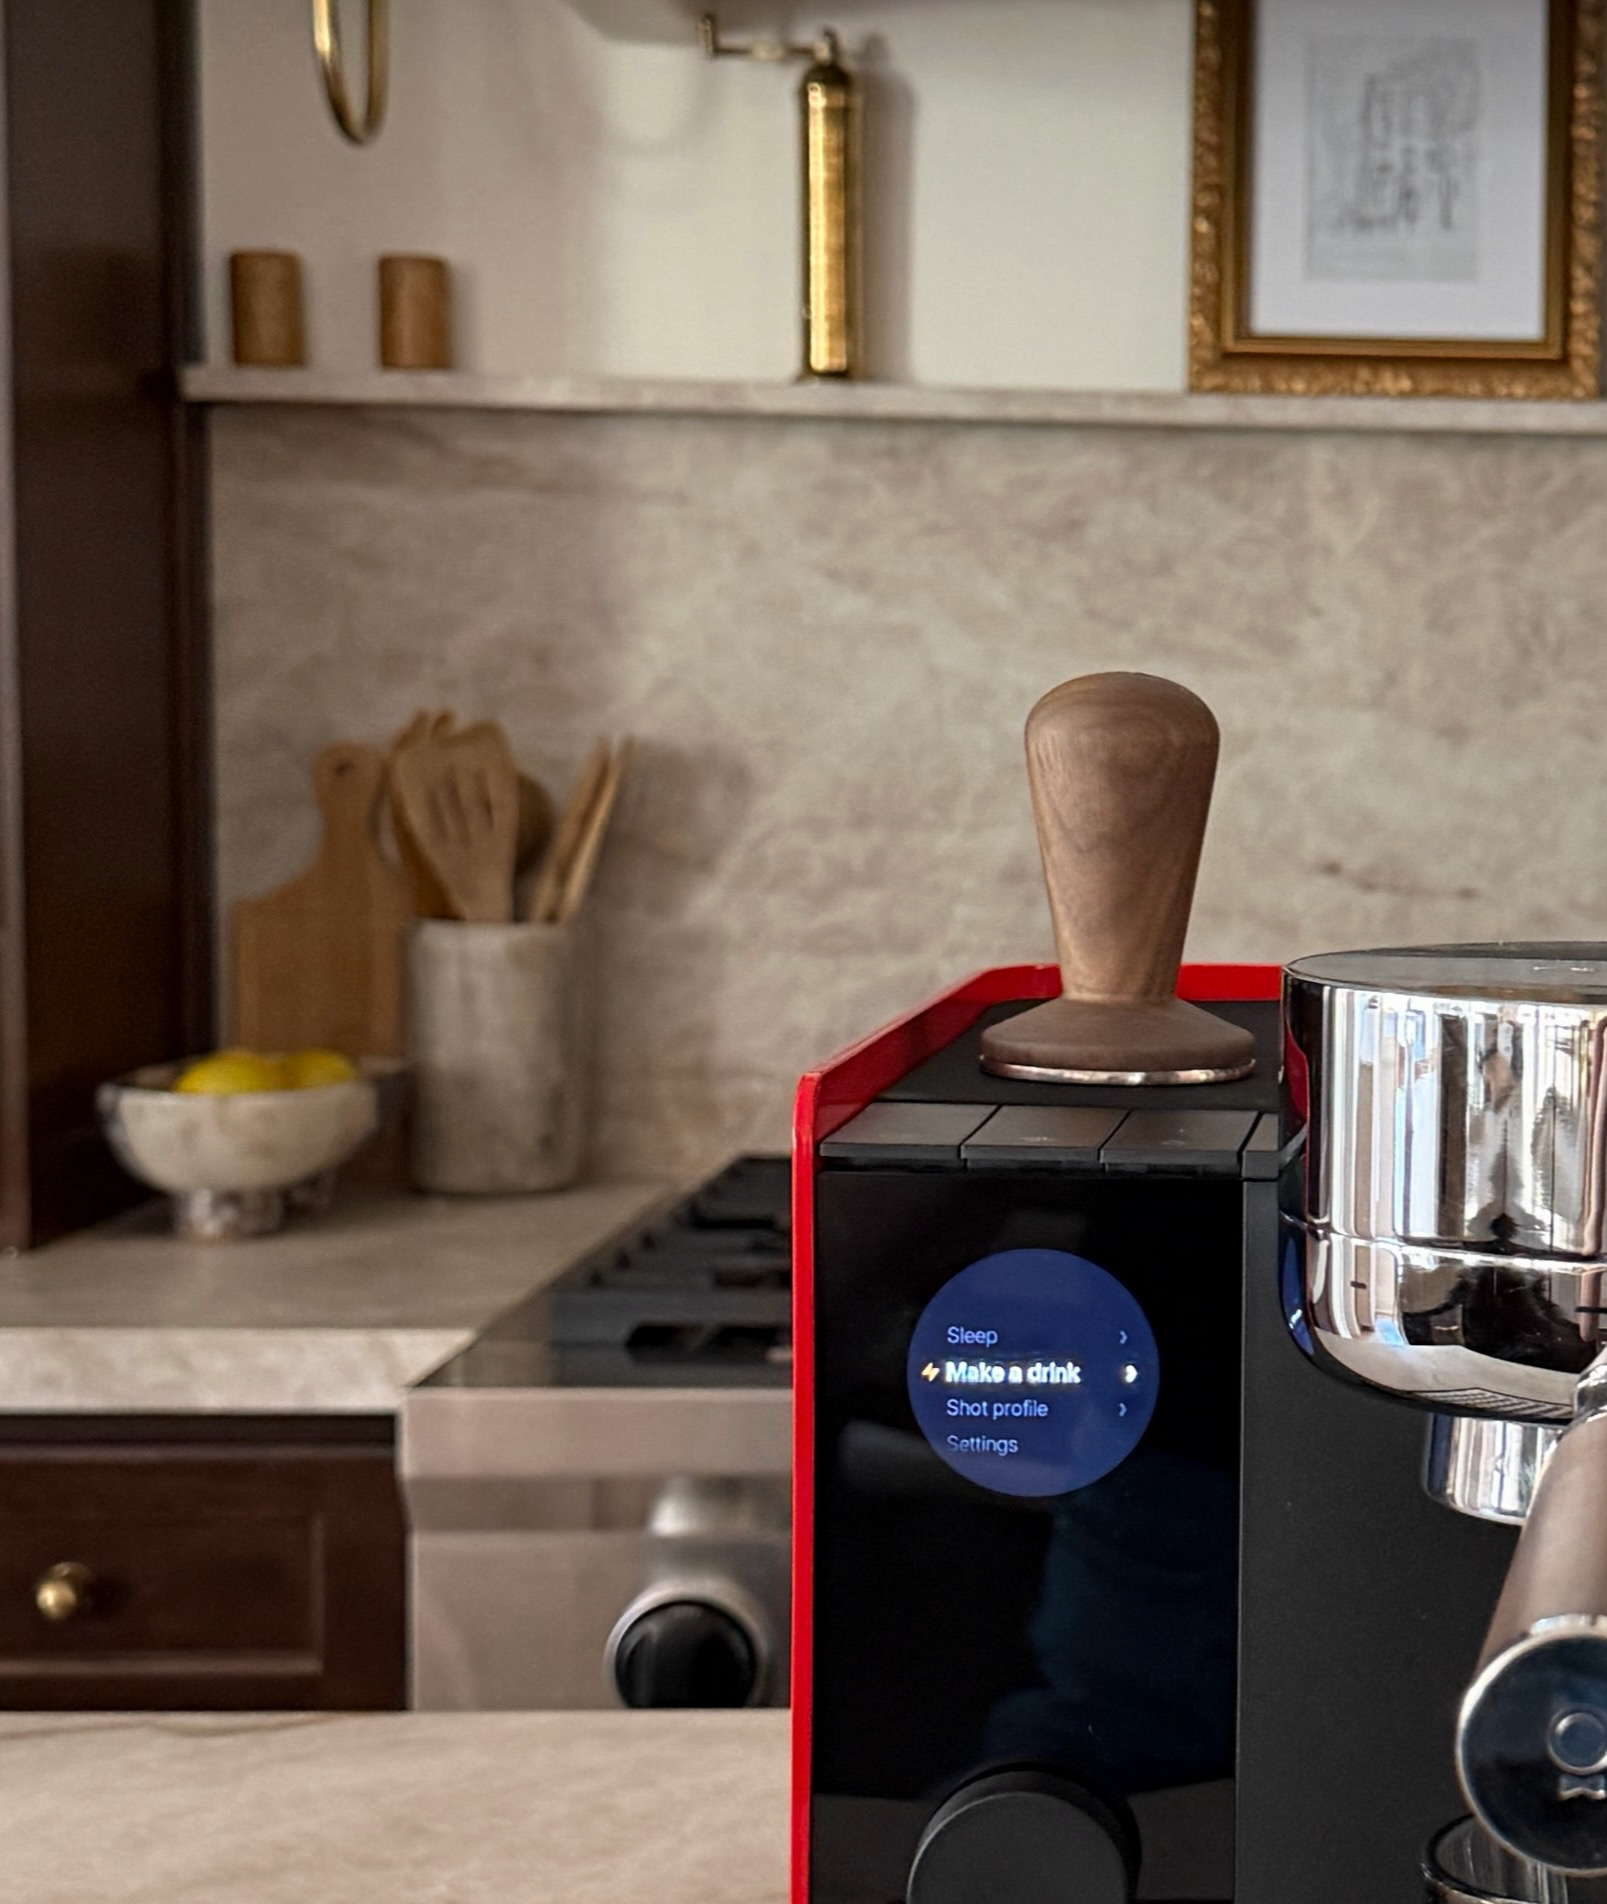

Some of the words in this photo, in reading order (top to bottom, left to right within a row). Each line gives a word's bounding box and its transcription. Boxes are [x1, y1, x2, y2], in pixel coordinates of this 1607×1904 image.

[946, 1326, 999, 1347] Sleep
[945, 1361, 1005, 1384] Make
[1008, 1364, 1023, 1384] a
[1026, 1361, 1081, 1384] drink
[946, 1399, 988, 1417] Shot
[992, 1399, 1049, 1420] profile
[946, 1435, 1019, 1456] Settings
